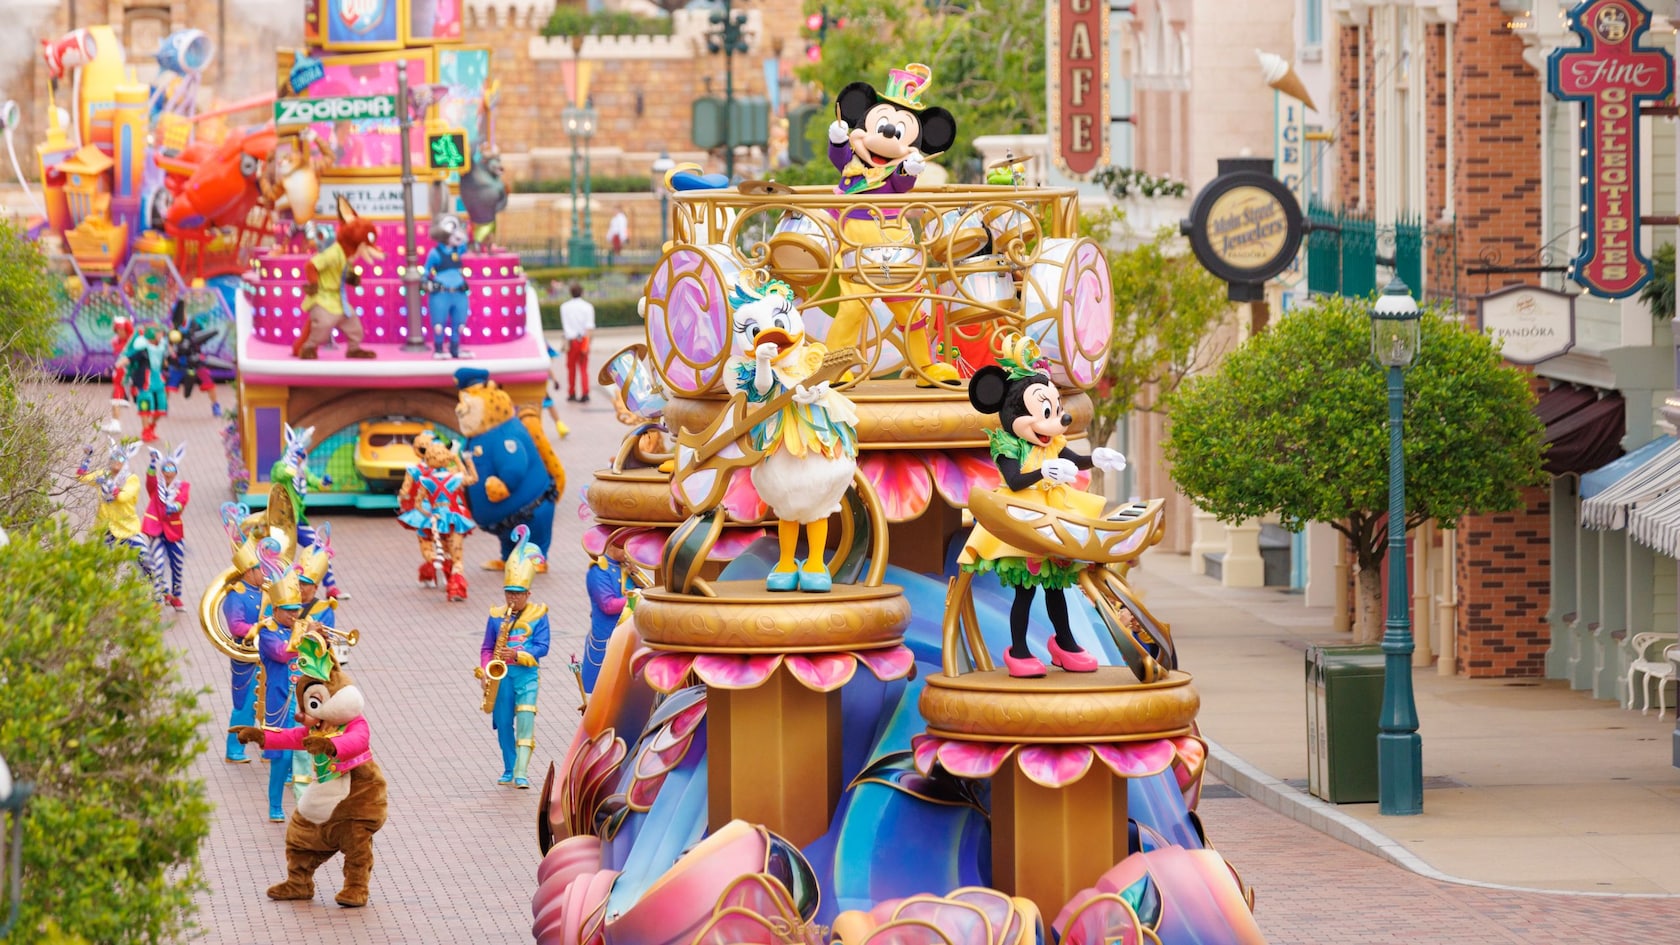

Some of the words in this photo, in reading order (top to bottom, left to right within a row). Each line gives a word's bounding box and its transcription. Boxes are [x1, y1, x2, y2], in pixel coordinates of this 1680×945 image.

[1571, 58, 1657, 89] Fine
[1282, 106, 1298, 164] ICE
[1600, 87, 1629, 281] COLLECTIBLES
[1213, 213, 1241, 235] Main
[1243, 200, 1274, 226] Street
[1222, 219, 1283, 256] Jewelers
[1499, 326, 1554, 337] PANDORA
